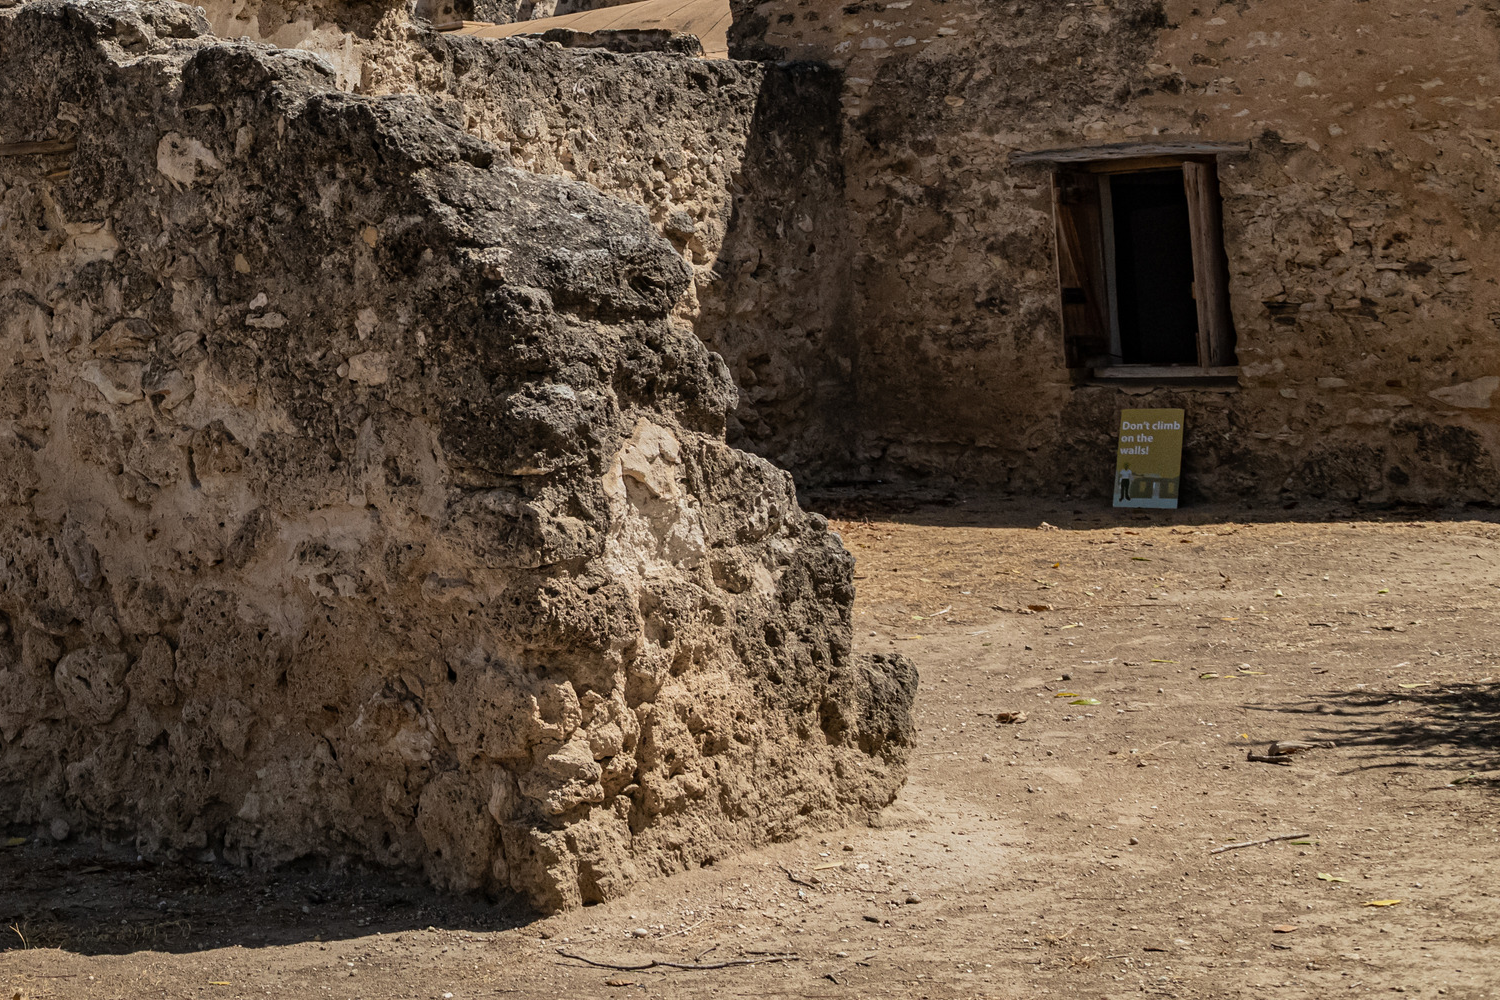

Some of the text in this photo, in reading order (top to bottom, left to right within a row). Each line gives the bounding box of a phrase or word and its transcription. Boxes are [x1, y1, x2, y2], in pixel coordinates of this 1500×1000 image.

[1122, 421, 1180, 430] Don't climb
[1137, 433, 1153, 442] the
[1120, 446, 1149, 455] walls!
